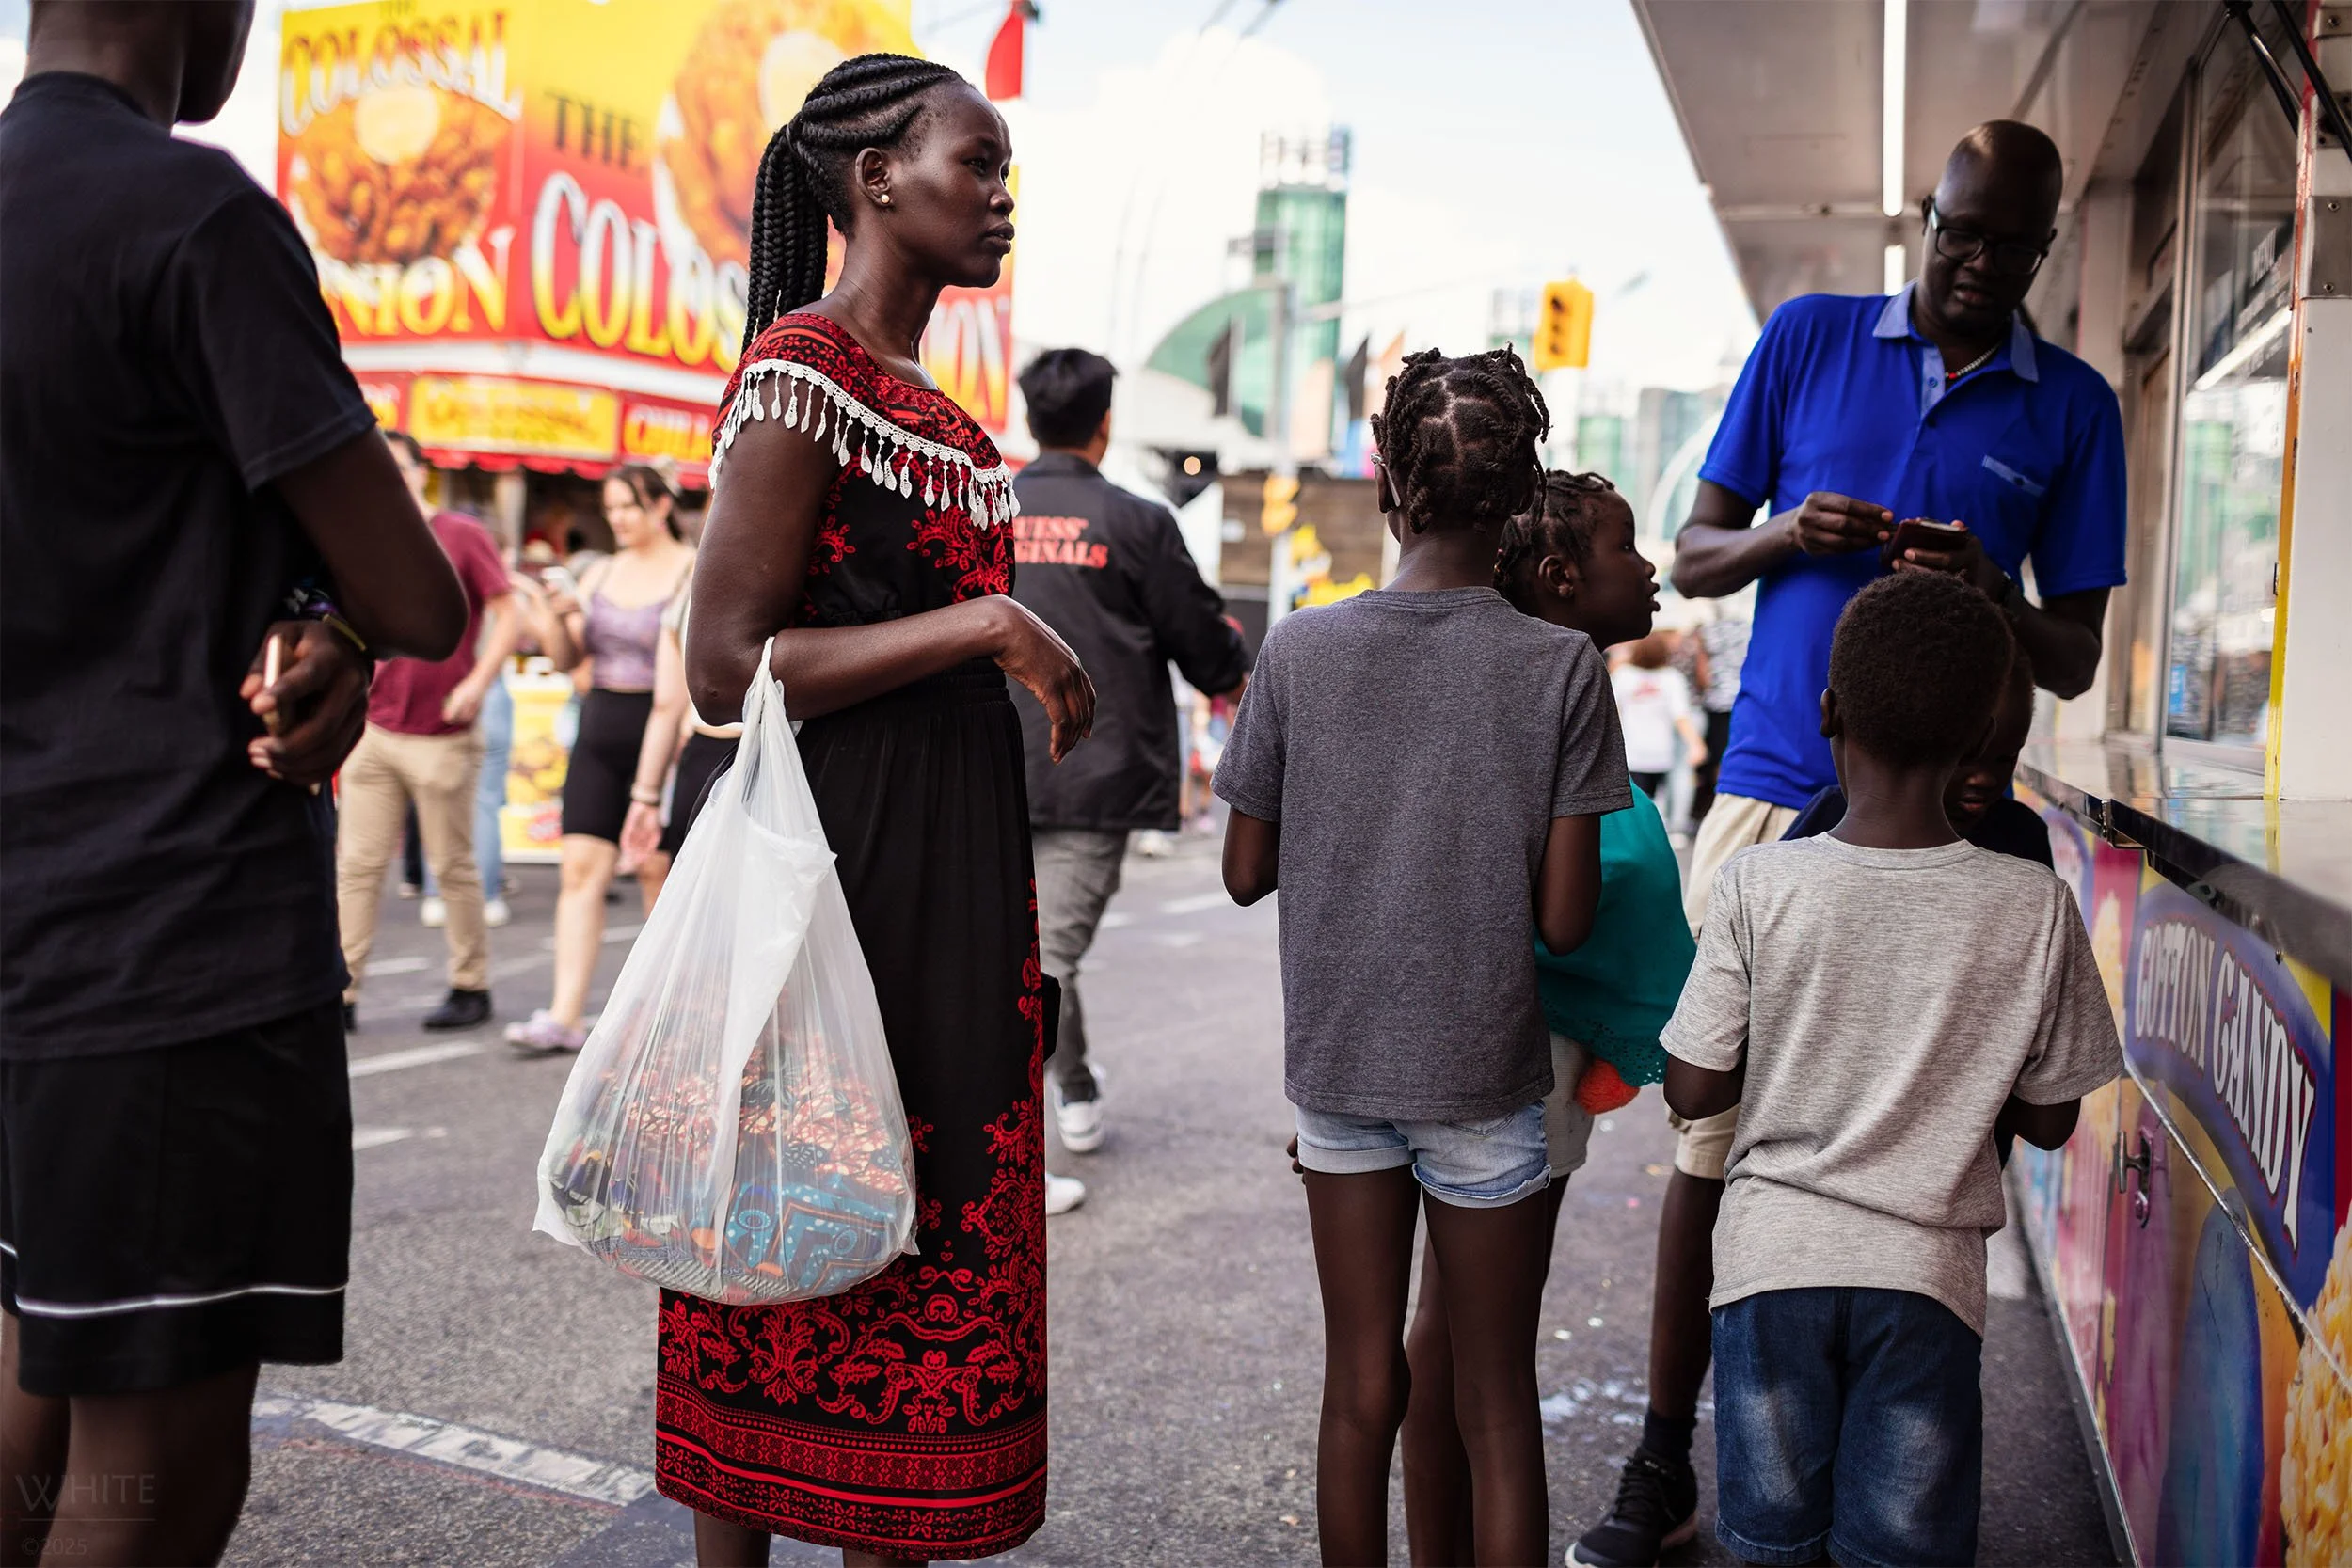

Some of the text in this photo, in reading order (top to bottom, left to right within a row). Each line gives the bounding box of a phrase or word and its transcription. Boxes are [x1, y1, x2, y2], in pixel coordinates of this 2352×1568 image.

[279, 10, 521, 138] COLOSSAL
[543, 90, 647, 174] THE
[317, 225, 517, 336] NION
[531, 170, 752, 374] COLOS
[1013, 515, 1089, 540] UESS
[1014, 540, 1108, 569] GINALS
[2135, 921, 2315, 1252] COTTON CANDY
